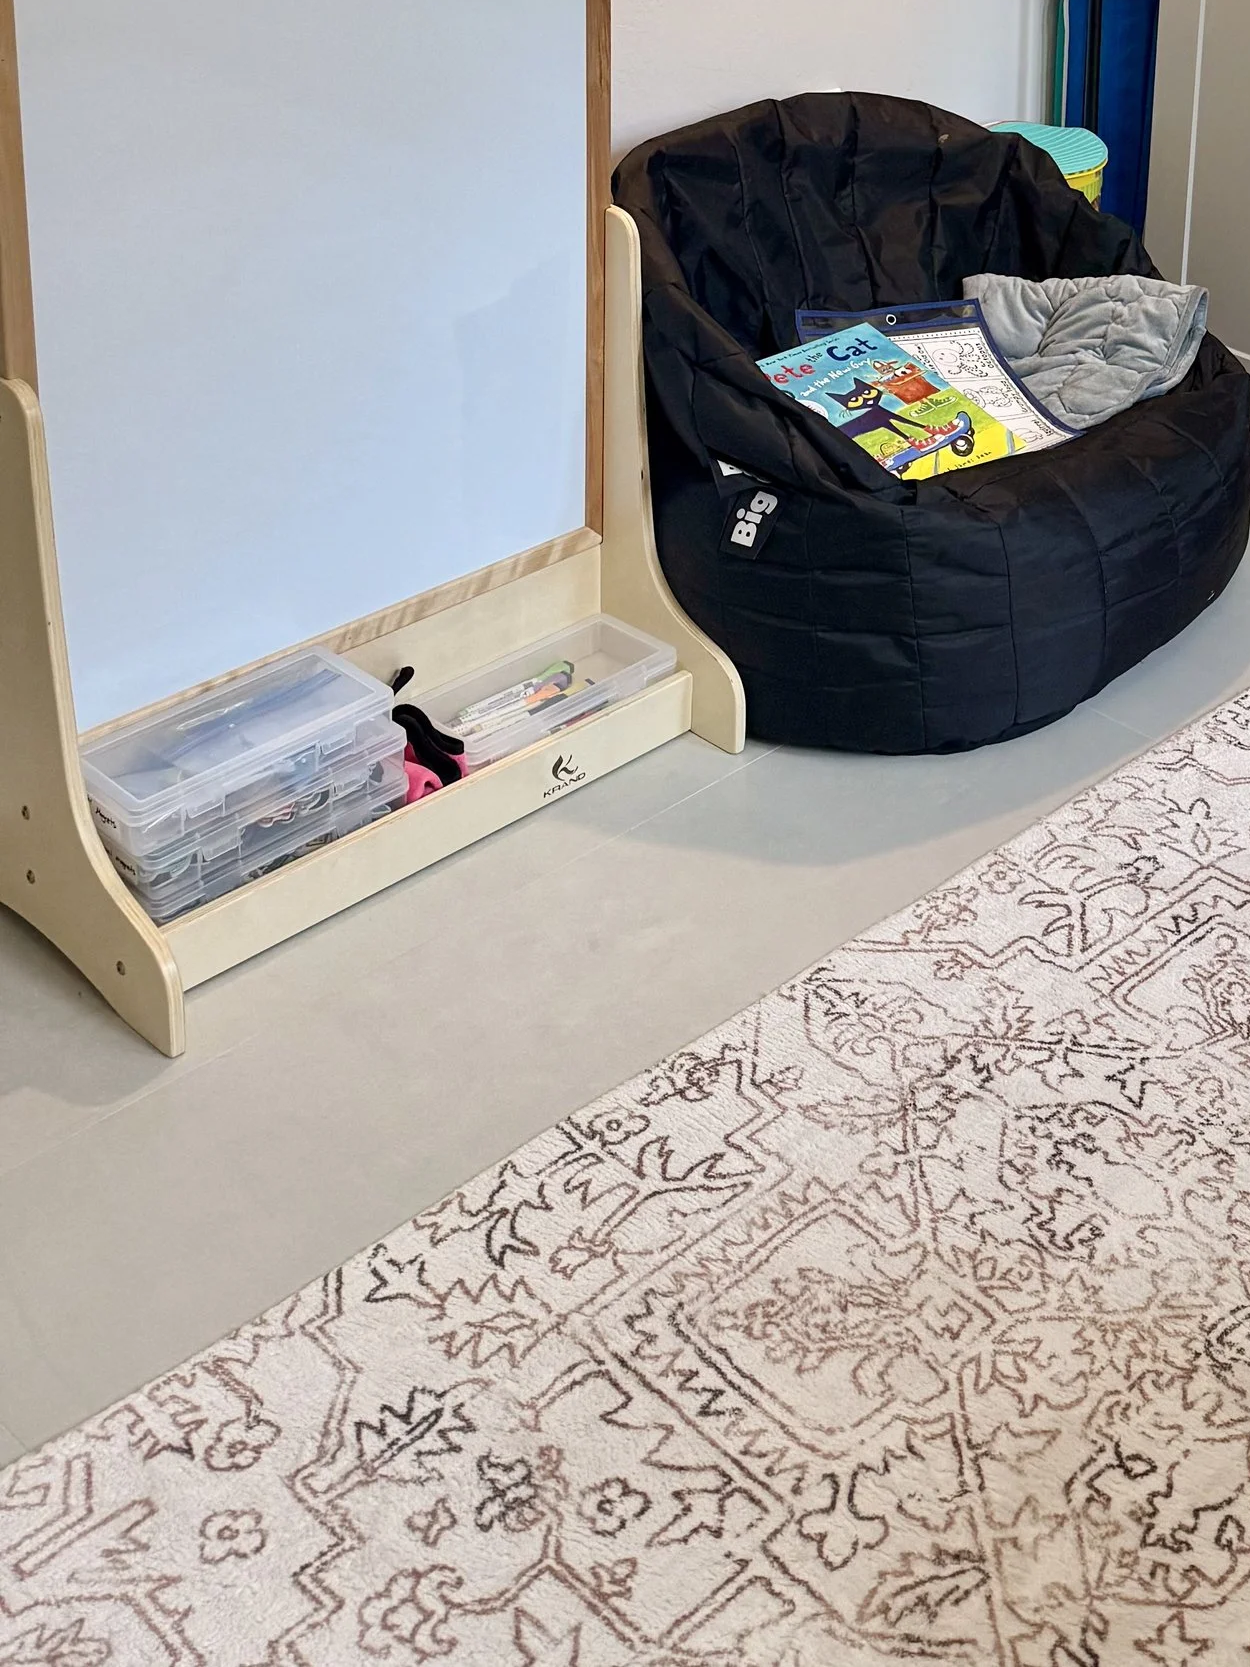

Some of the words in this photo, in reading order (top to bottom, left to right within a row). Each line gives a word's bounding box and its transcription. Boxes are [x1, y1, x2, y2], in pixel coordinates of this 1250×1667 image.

[807, 352, 824, 364] the
[826, 337, 879, 362] Cat
[975, 342, 995, 370] Octopus
[815, 375, 831, 391] the
[831, 366, 851, 380] New
[850, 357, 872, 371] Guy
[730, 490, 779, 548] Big
